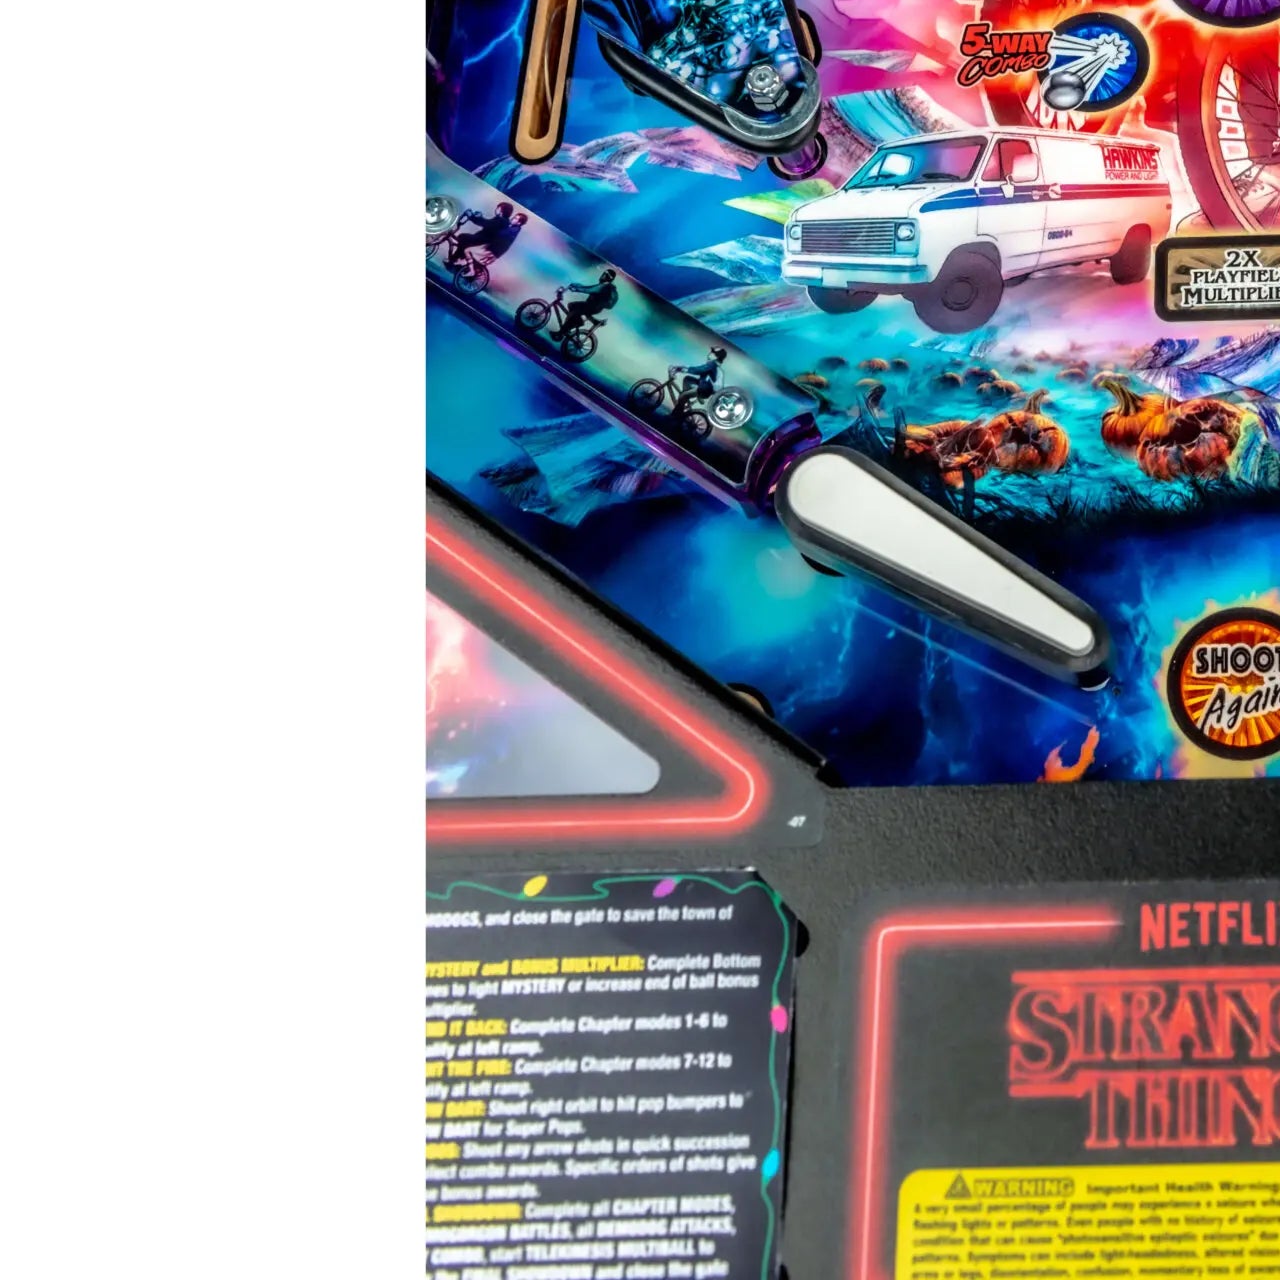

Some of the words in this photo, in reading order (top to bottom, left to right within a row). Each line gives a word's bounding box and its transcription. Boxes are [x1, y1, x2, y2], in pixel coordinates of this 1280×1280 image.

[960, 23, 1052, 55] 5-WAY
[1103, 147, 1160, 170] HAWKINS
[1226, 250, 1260, 267] 2X
[607, 906, 621, 922] to
[624, 908, 656, 922] save
[657, 905, 680, 921] the
[681, 904, 716, 921] town
[718, 904, 734, 920] of
[647, 954, 710, 972] Complete
[713, 953, 762, 969] Bottom
[585, 976, 643, 992] increase
[644, 975, 671, 991] end
[672, 974, 687, 990] of
[689, 972, 715, 989] ball
[717, 973, 760, 988] bonus
[685, 1013, 710, 1028] 1-6
[712, 1012, 729, 1028] to
[683, 1052, 715, 1069] 7-12
[717, 1051, 733, 1068] to
[729, 1092, 744, 1109] to
